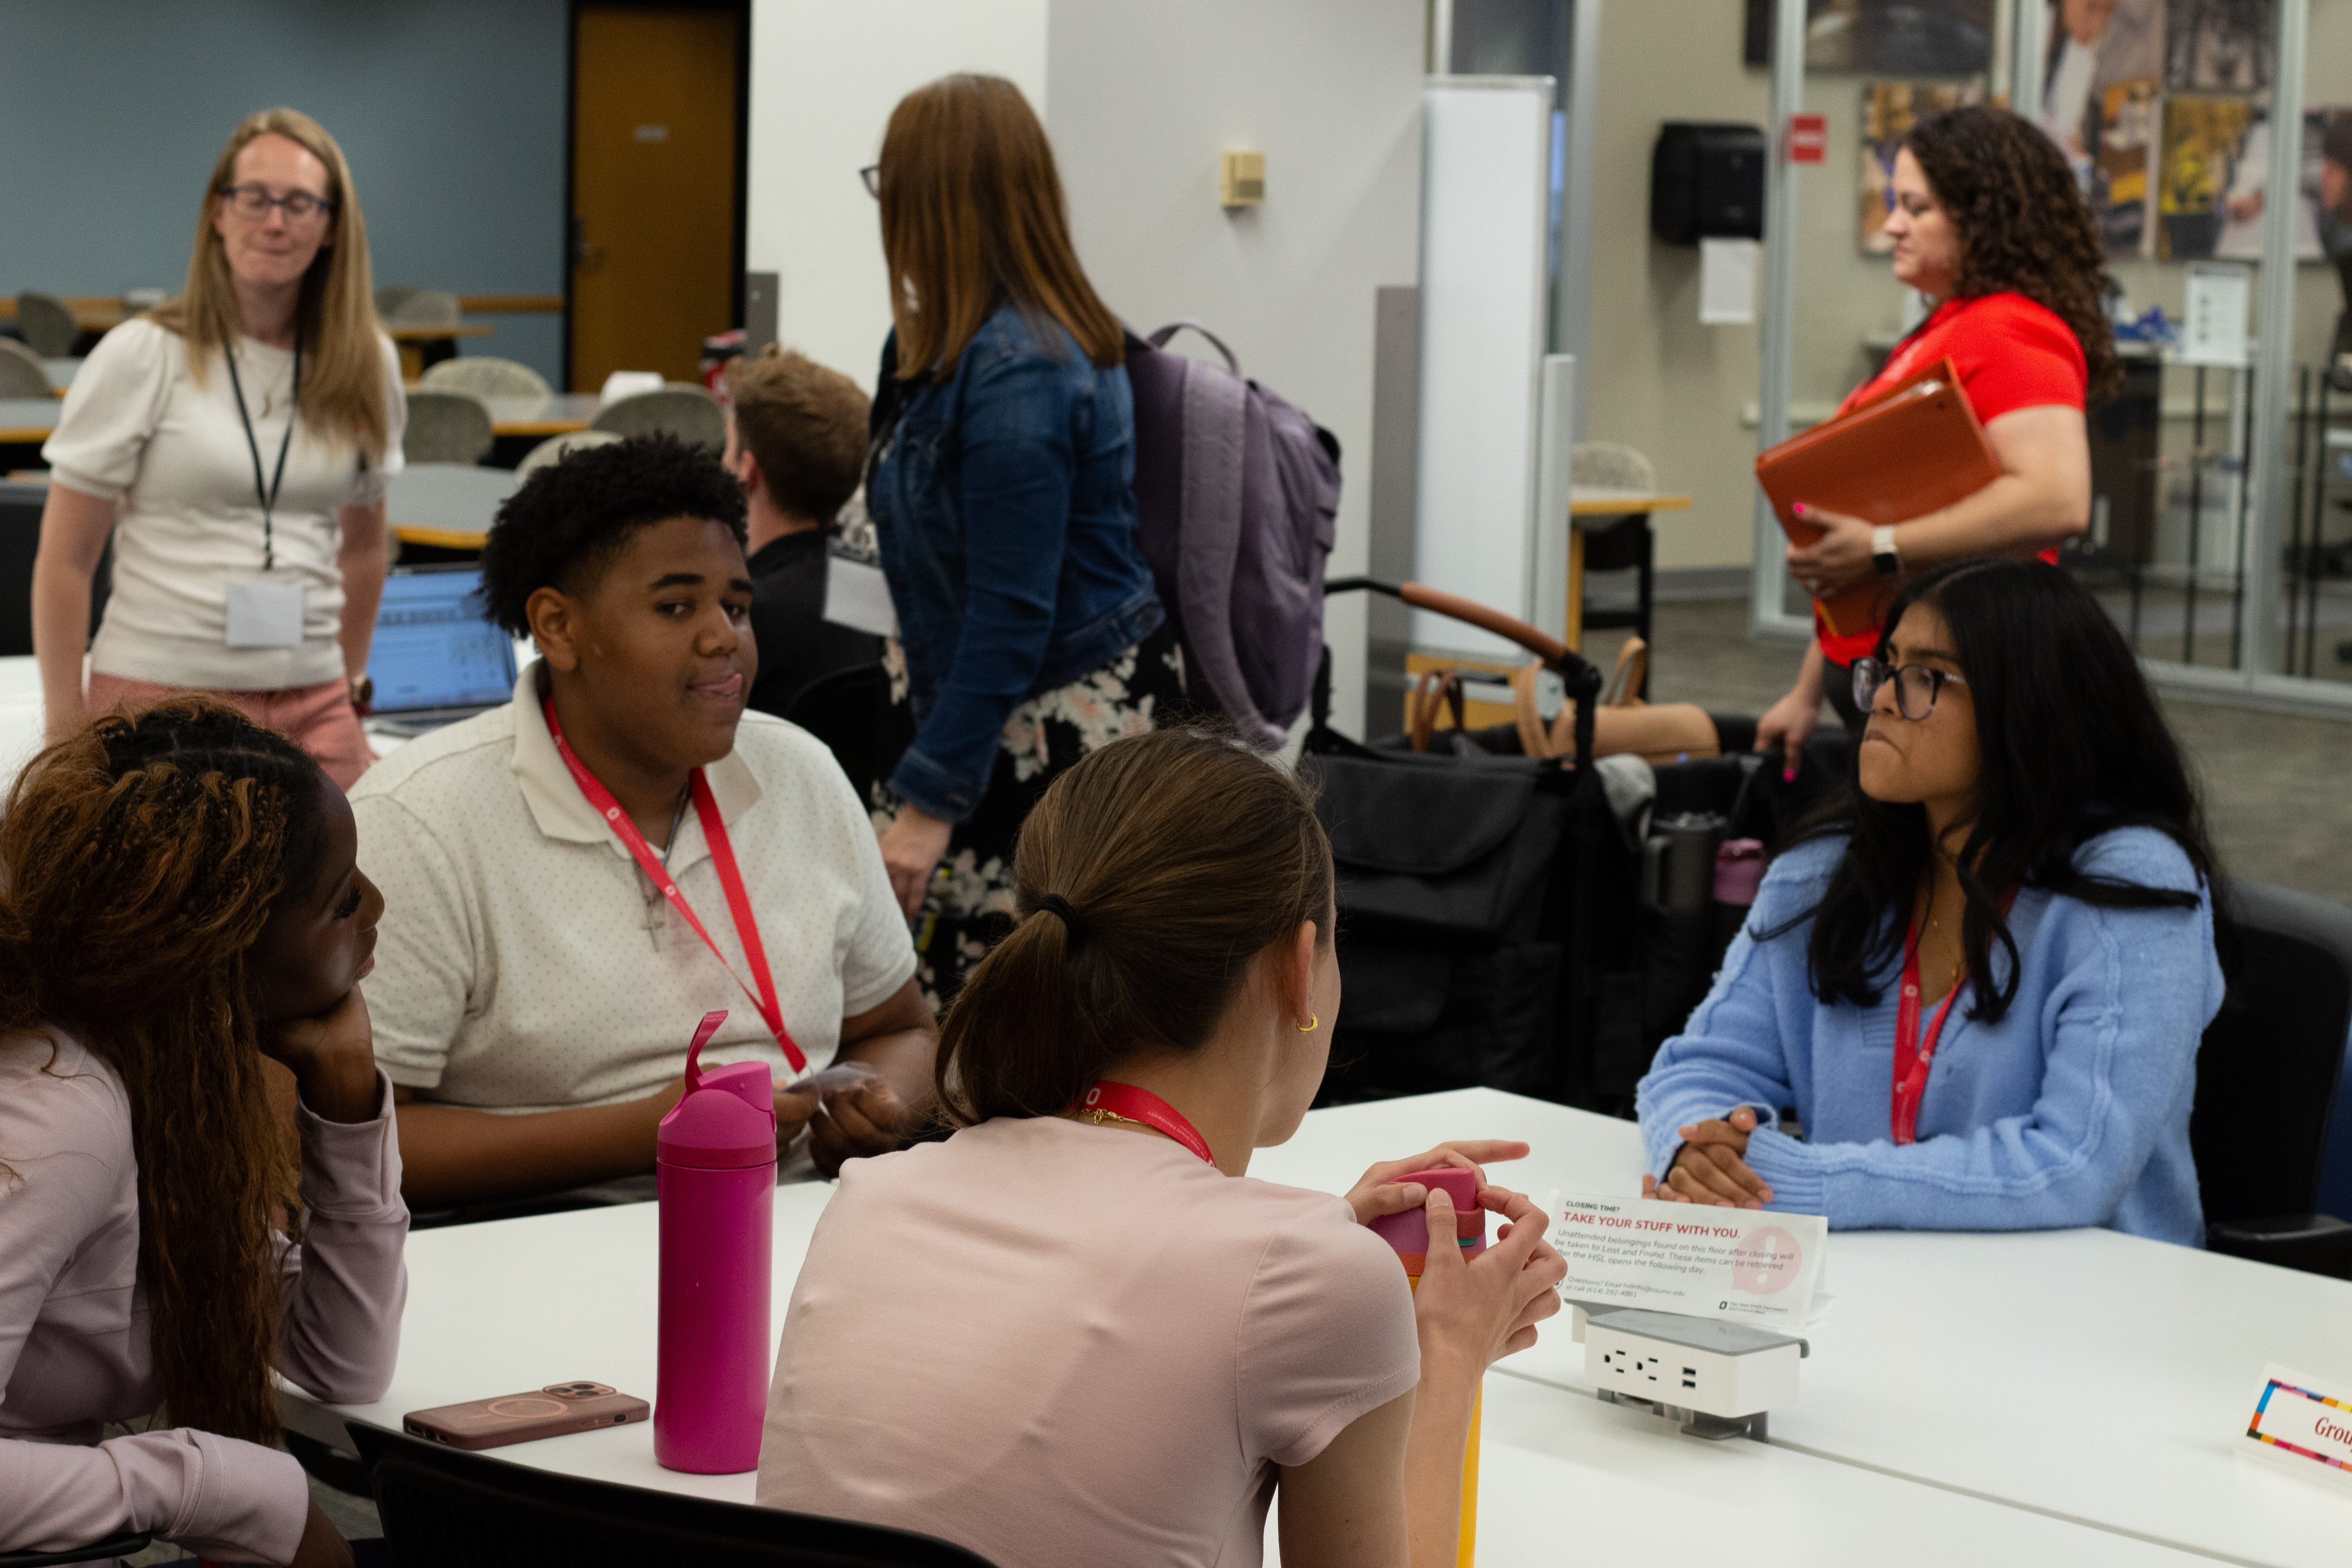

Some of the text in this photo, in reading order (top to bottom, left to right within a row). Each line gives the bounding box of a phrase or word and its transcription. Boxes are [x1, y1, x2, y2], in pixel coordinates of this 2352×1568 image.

[1566, 1200, 1598, 1210] CLOSING
[1564, 1211, 1740, 1239] TAKE YOUR STUFF WITH YOU.
[1558, 1229, 1607, 1241] Unattended
[1608, 1236, 1651, 1248] belongings
[1654, 1241, 1677, 1250] found
[1708, 1246, 1726, 1255] floor
[1749, 1250, 1778, 1260] closing
[1779, 1253, 1795, 1261] will
[1568, 1240, 1589, 1249] taken
[1602, 1245, 1620, 1254] Lost
[1622, 1248, 1637, 1256] and
[1669, 1252, 1692, 1262] These
[1695, 1255, 1717, 1264] items
[1747, 1261, 1784, 1271] retrieved
[1573, 1251, 1586, 1259] the
[1588, 1253, 1606, 1263] HSL
[1607, 1257, 1632, 1266] opens
[1649, 1260, 1687, 1273] following
[1688, 1265, 1705, 1275] day.
[1568, 1276, 1604, 1286] Questions?
[1587, 1287, 1604, 1295] (614)
[2314, 1416, 2352, 1453] Grou
